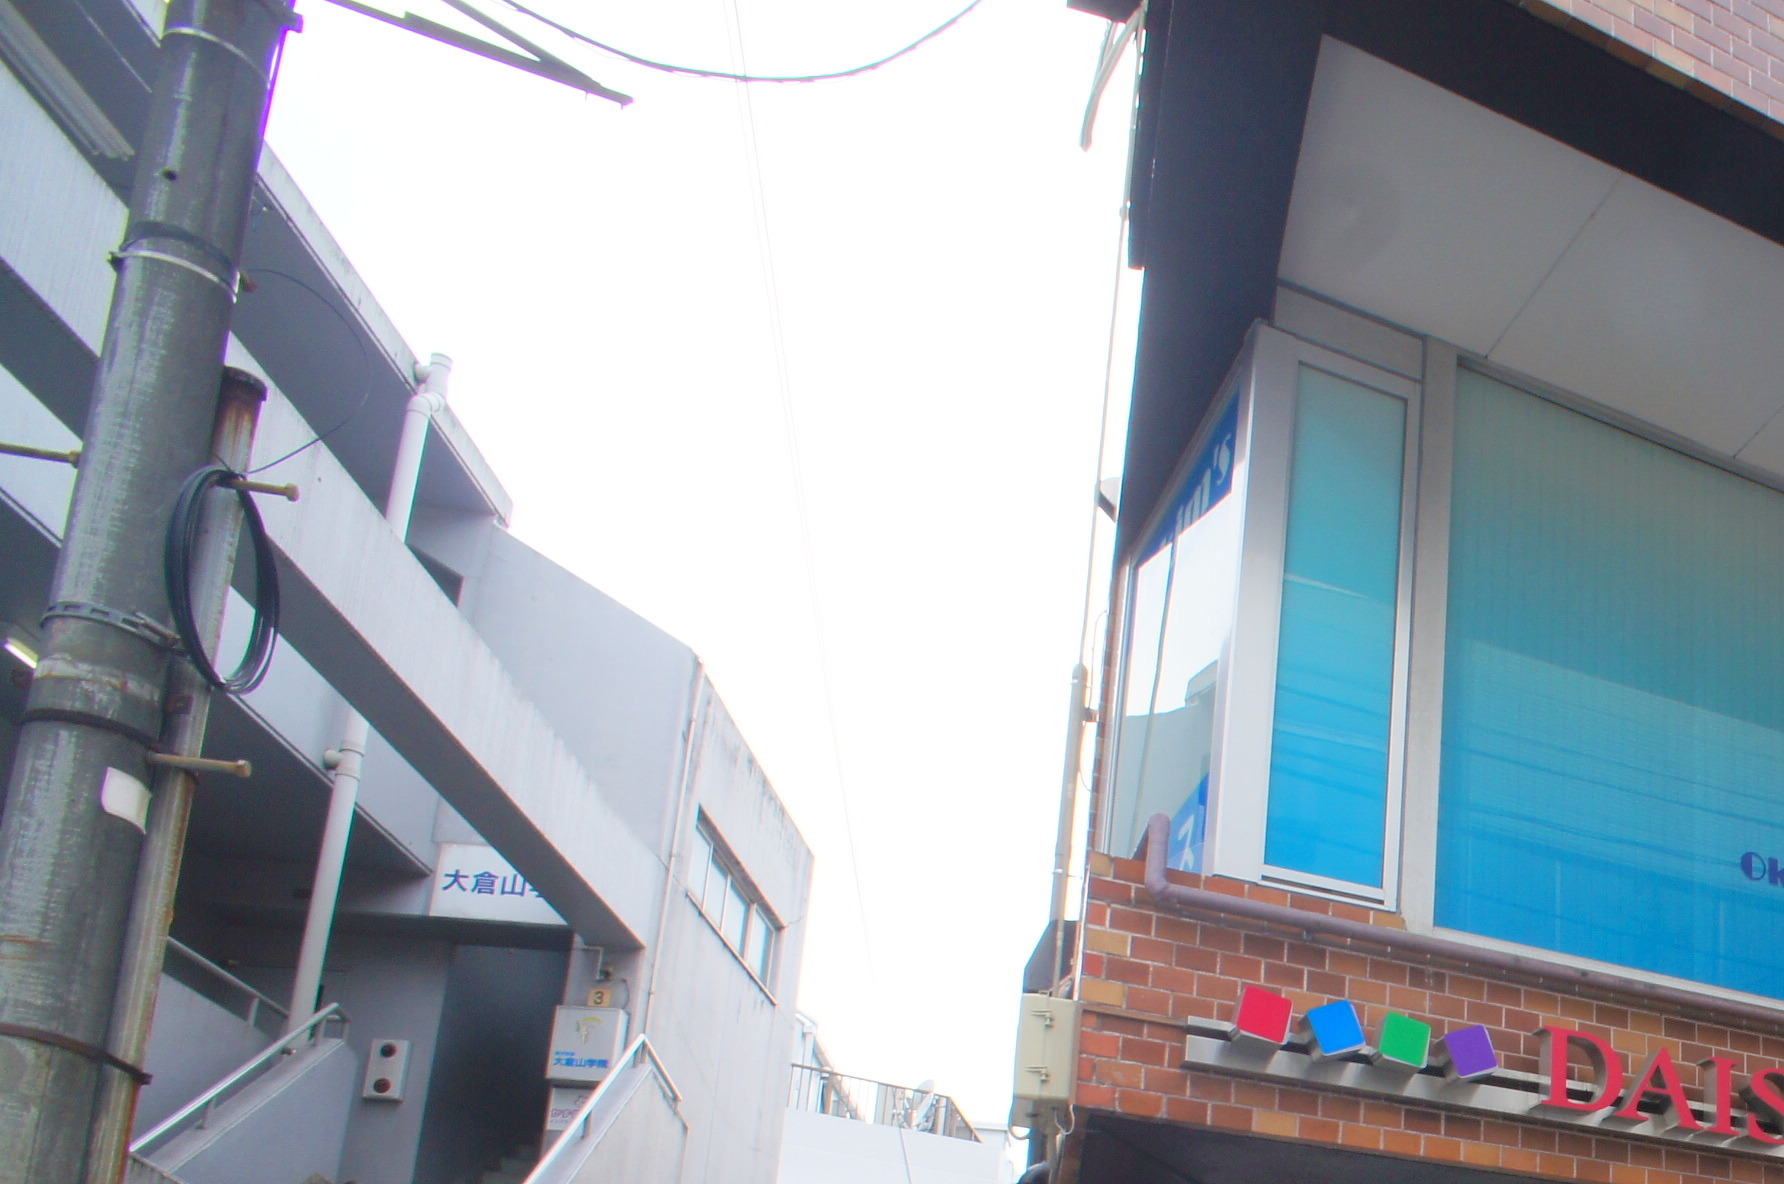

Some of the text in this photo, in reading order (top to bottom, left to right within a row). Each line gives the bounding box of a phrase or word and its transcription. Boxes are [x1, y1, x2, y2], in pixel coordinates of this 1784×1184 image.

[442, 868, 543, 899] 大倉山
[593, 990, 604, 1005] 3
